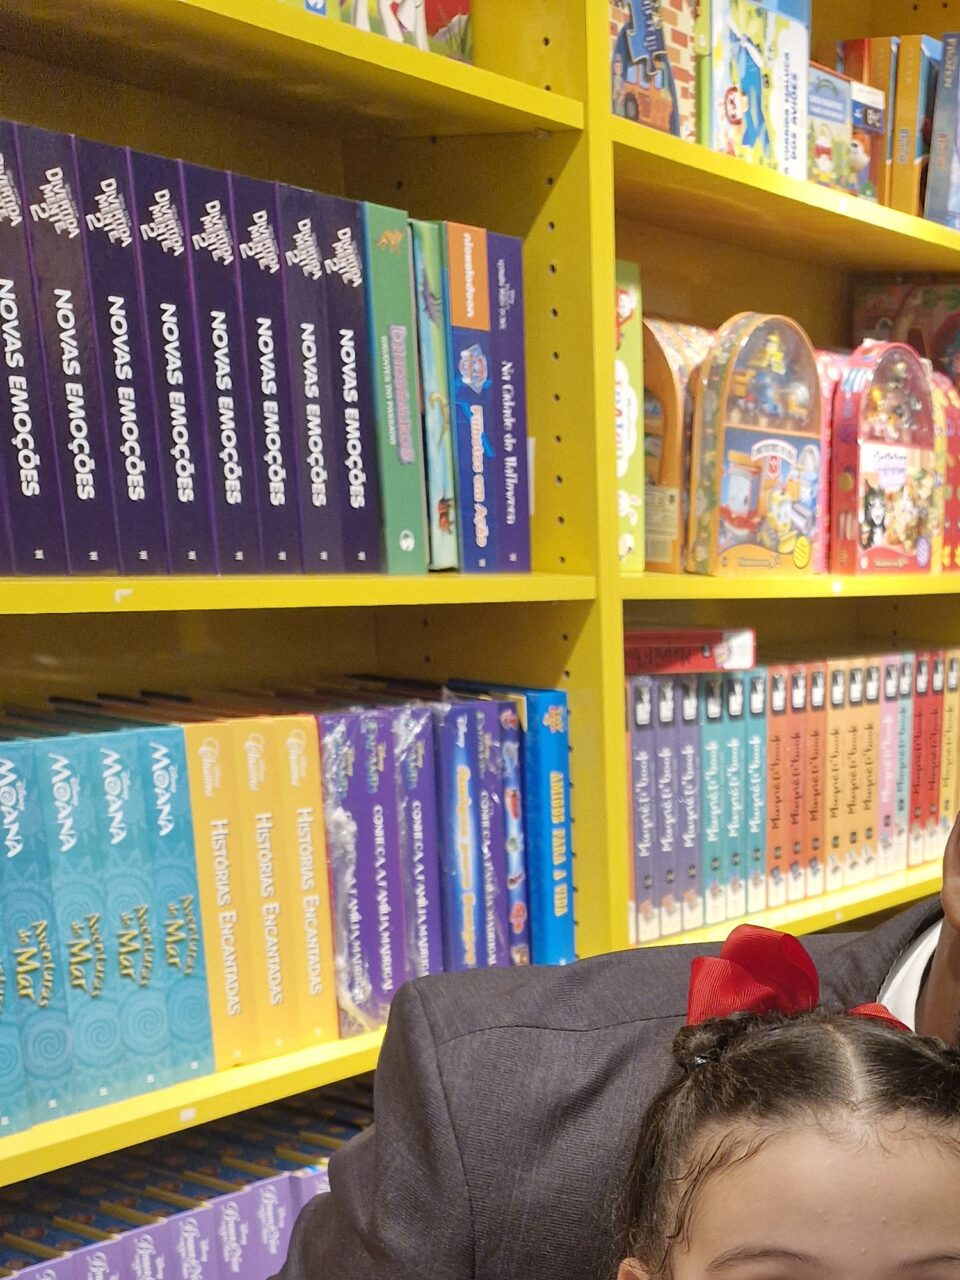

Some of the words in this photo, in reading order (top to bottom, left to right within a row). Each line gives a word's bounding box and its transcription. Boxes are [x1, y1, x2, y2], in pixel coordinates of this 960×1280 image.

[0, 153, 22, 227] IVERTIDA
[29, 202, 50, 221] 2
[85, 212, 104, 231] 2
[140, 223, 157, 240] 2
[192, 232, 208, 250] 2
[239, 242, 255, 259] 2
[285, 250, 300, 266] 2
[324, 258, 339, 274] 2
[0, 278, 24, 368] NOVAS
[53, 288, 81, 376] NOVAS
[108, 295, 133, 381] NOVAS
[160, 303, 183, 386] NOVAS
[210, 310, 233, 391] NOVAS
[256, 317, 277, 395] NOVAS
[300, 322, 320, 398] NOVAS
[339, 328, 359, 403] NOVAS
[8, 375, 40, 497] EMOÇÕES
[65, 382, 96, 500] EMOÇÕES
[117, 386, 146, 501] EMOÇÕES
[168, 391, 195, 503] EMOÇÕES
[217, 396, 243, 505] EMOÇÕES
[262, 400, 287, 506] EMOÇÕES
[306, 403, 328, 507] EMOÇÕES
[344, 407, 367, 509] EMOÇÕES
[0, 757, 23, 858] MOANA
[48, 752, 77, 852] MOANA
[100, 747, 127, 845] MOANA
[149, 742, 175, 836] MOANA
